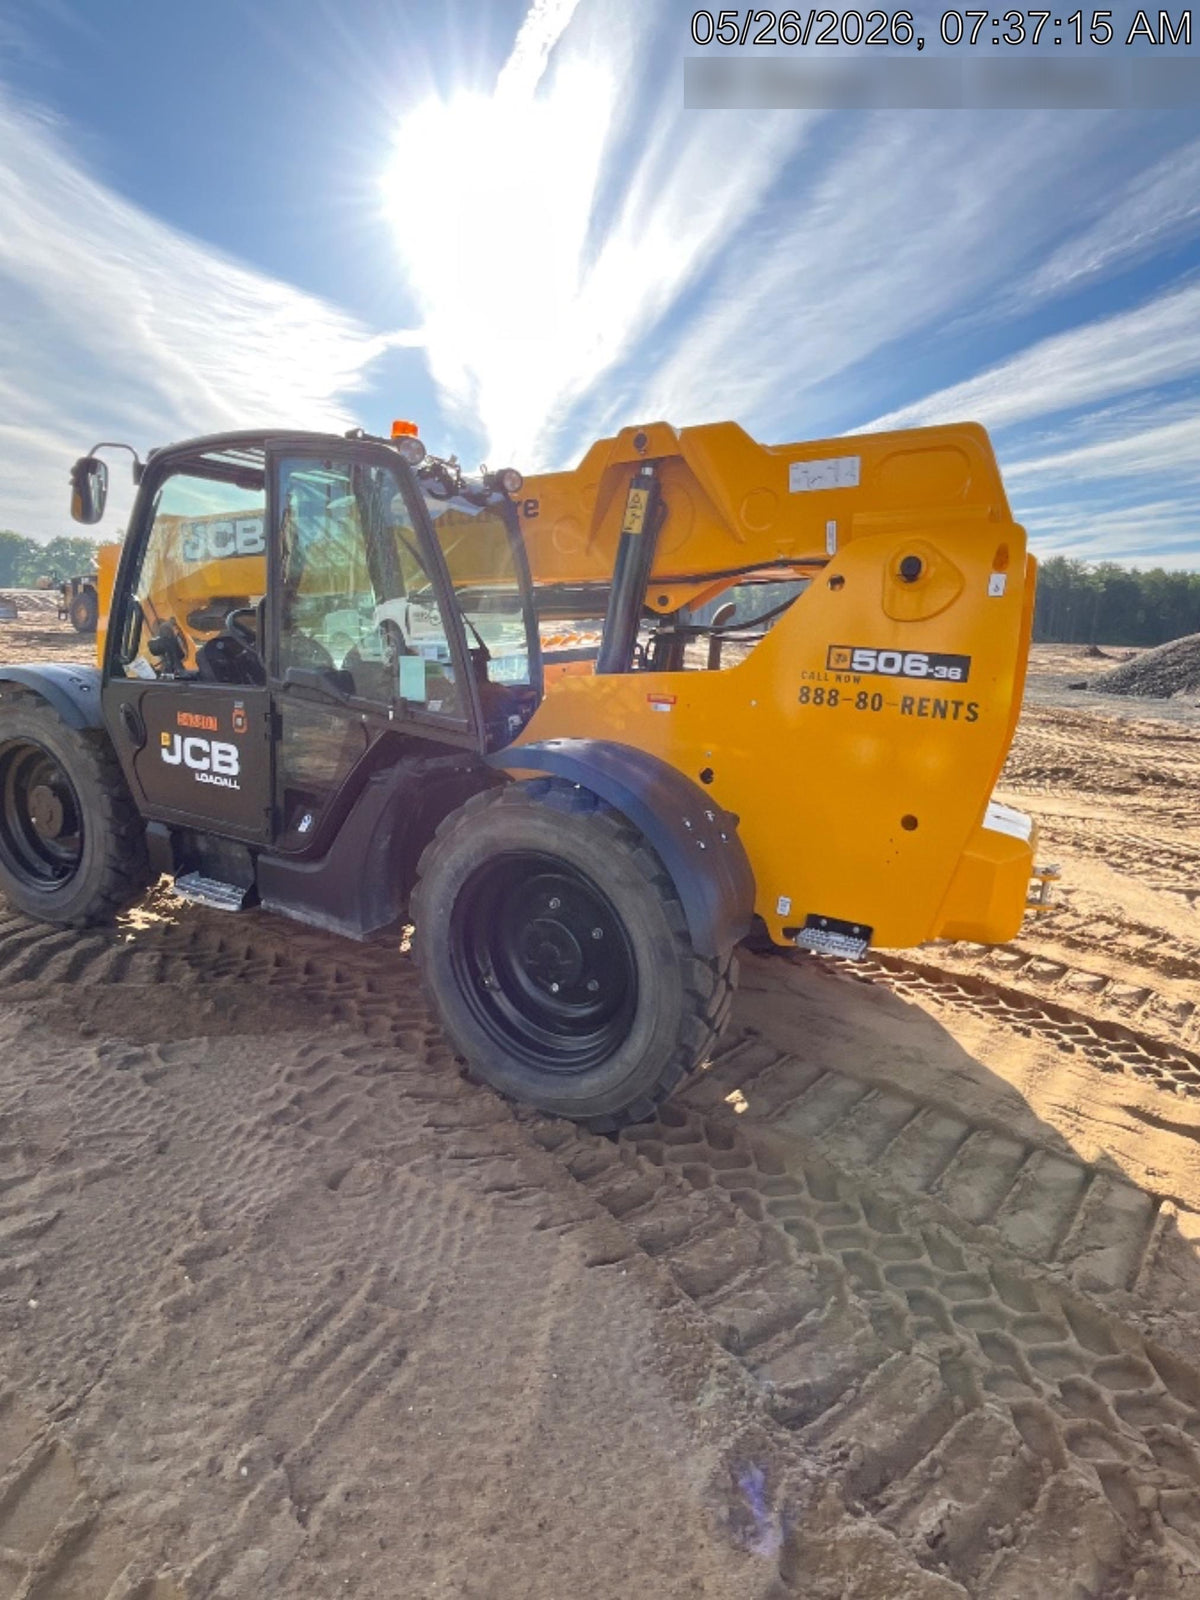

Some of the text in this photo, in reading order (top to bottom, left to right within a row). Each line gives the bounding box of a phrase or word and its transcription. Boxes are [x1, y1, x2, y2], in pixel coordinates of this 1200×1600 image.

[183, 518, 266, 562] JCB
[801, 671, 861, 684] CALL NOW
[799, 685, 980, 723] 888-80-RENTS
[160, 733, 240, 776] JCB
[195, 773, 240, 790] LOADALL
